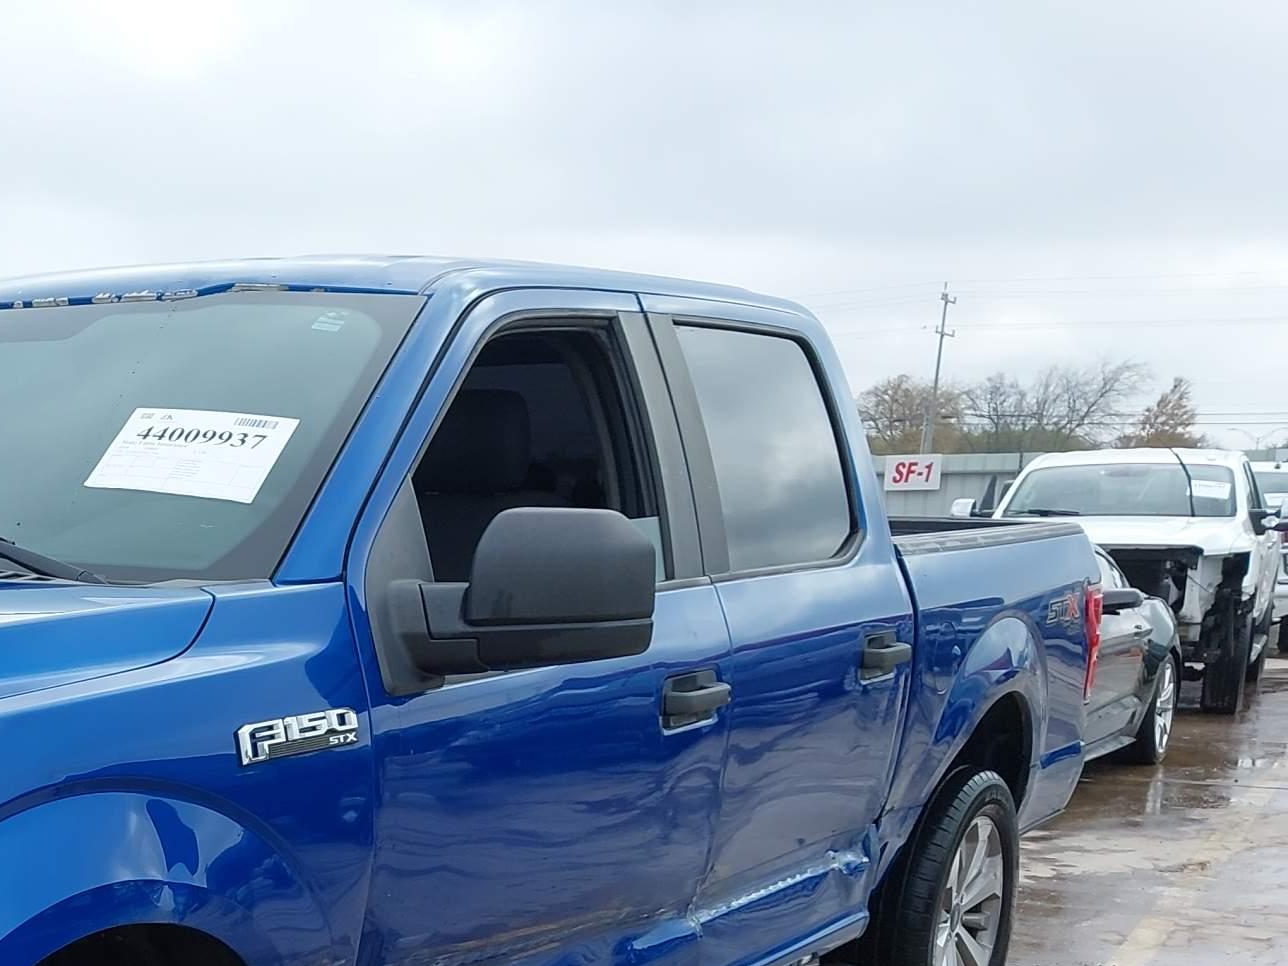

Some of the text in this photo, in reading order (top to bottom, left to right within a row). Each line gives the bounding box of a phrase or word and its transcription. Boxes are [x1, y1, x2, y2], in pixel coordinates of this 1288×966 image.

[136, 425, 269, 450] 44009937
[892, 461, 934, 484] SF-1
[1047, 594, 1080, 624] STX
[328, 731, 358, 745] STX
